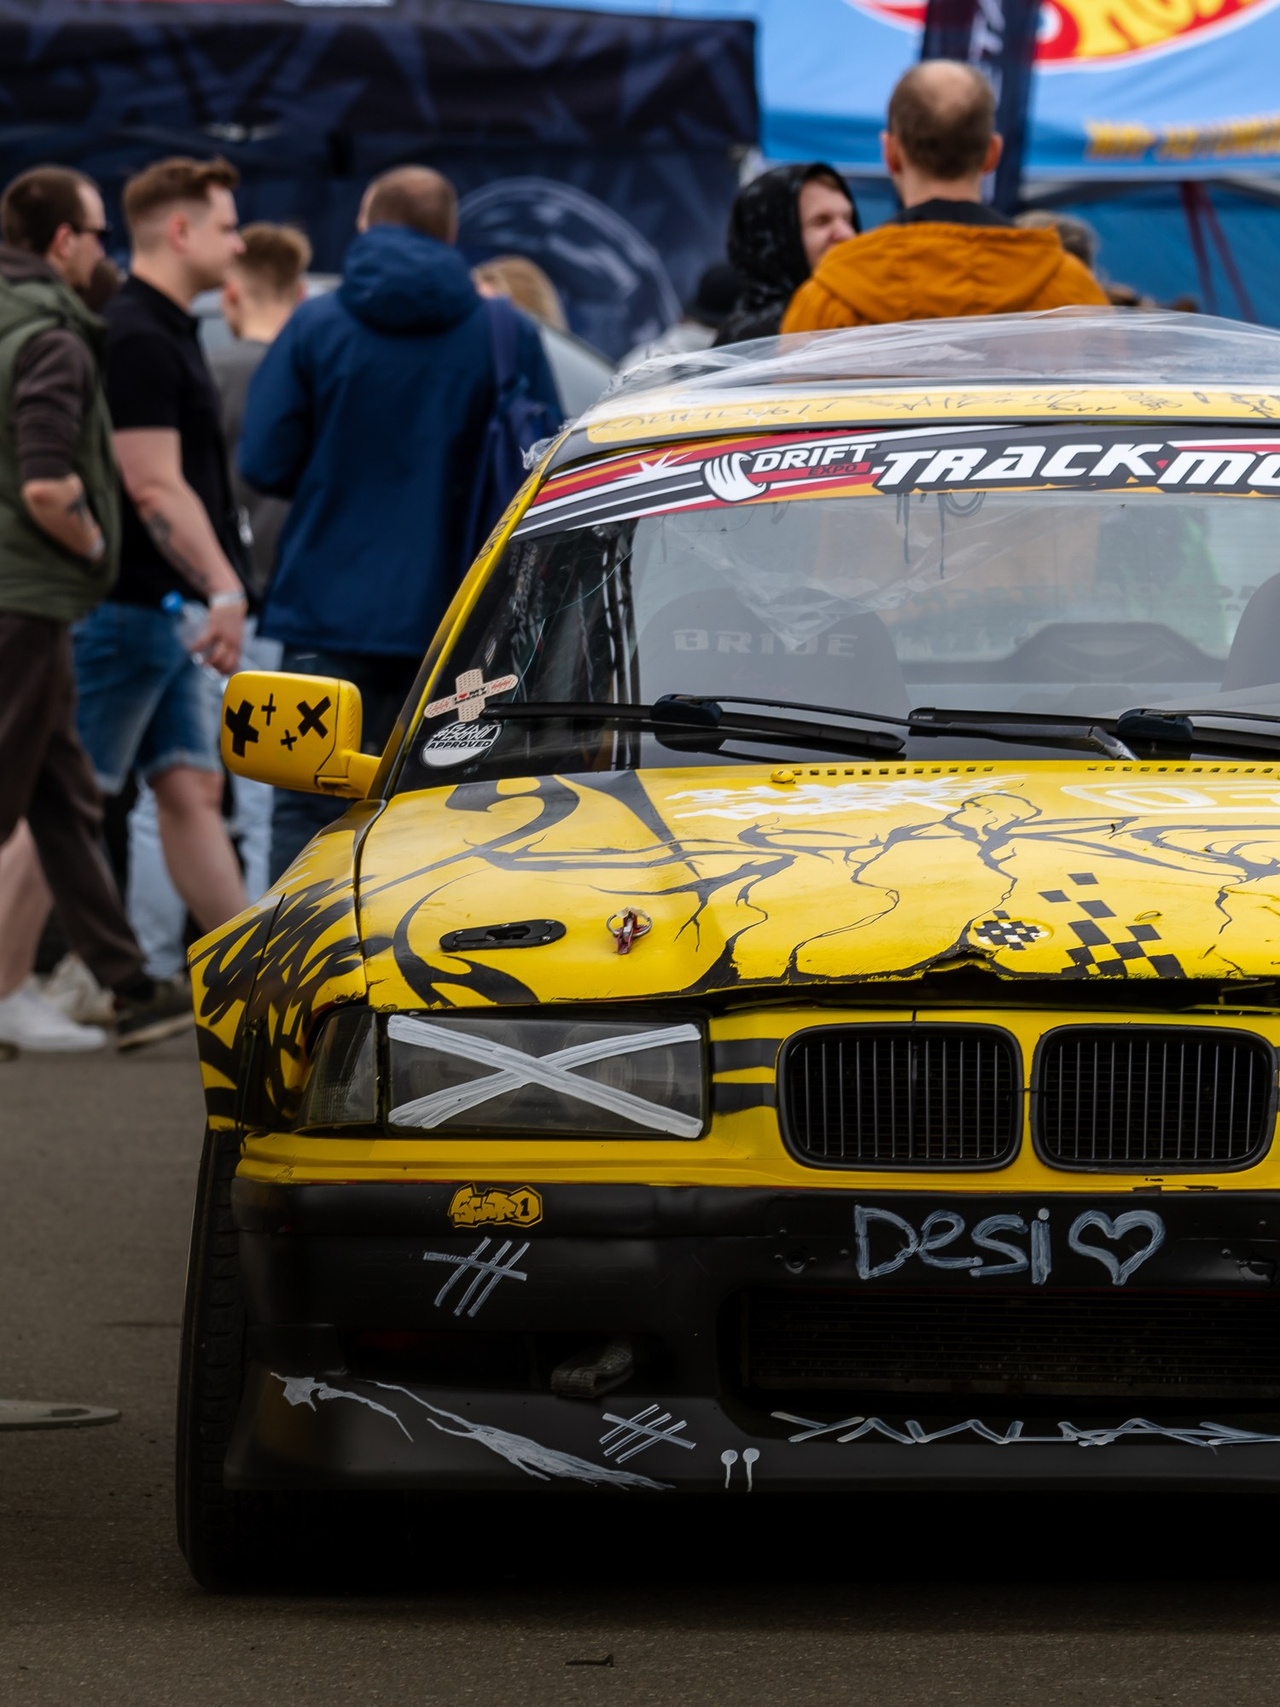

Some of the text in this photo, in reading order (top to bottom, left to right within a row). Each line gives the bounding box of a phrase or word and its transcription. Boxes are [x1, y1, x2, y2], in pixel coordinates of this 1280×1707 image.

[752, 443, 878, 474] DRIFT
[807, 462, 859, 478] EXPO
[872, 443, 1165, 488] TRACK
[672, 628, 858, 658] BRIDE
[428, 740, 492, 750] APPROVED
[854, 1204, 1052, 1286] Desi
